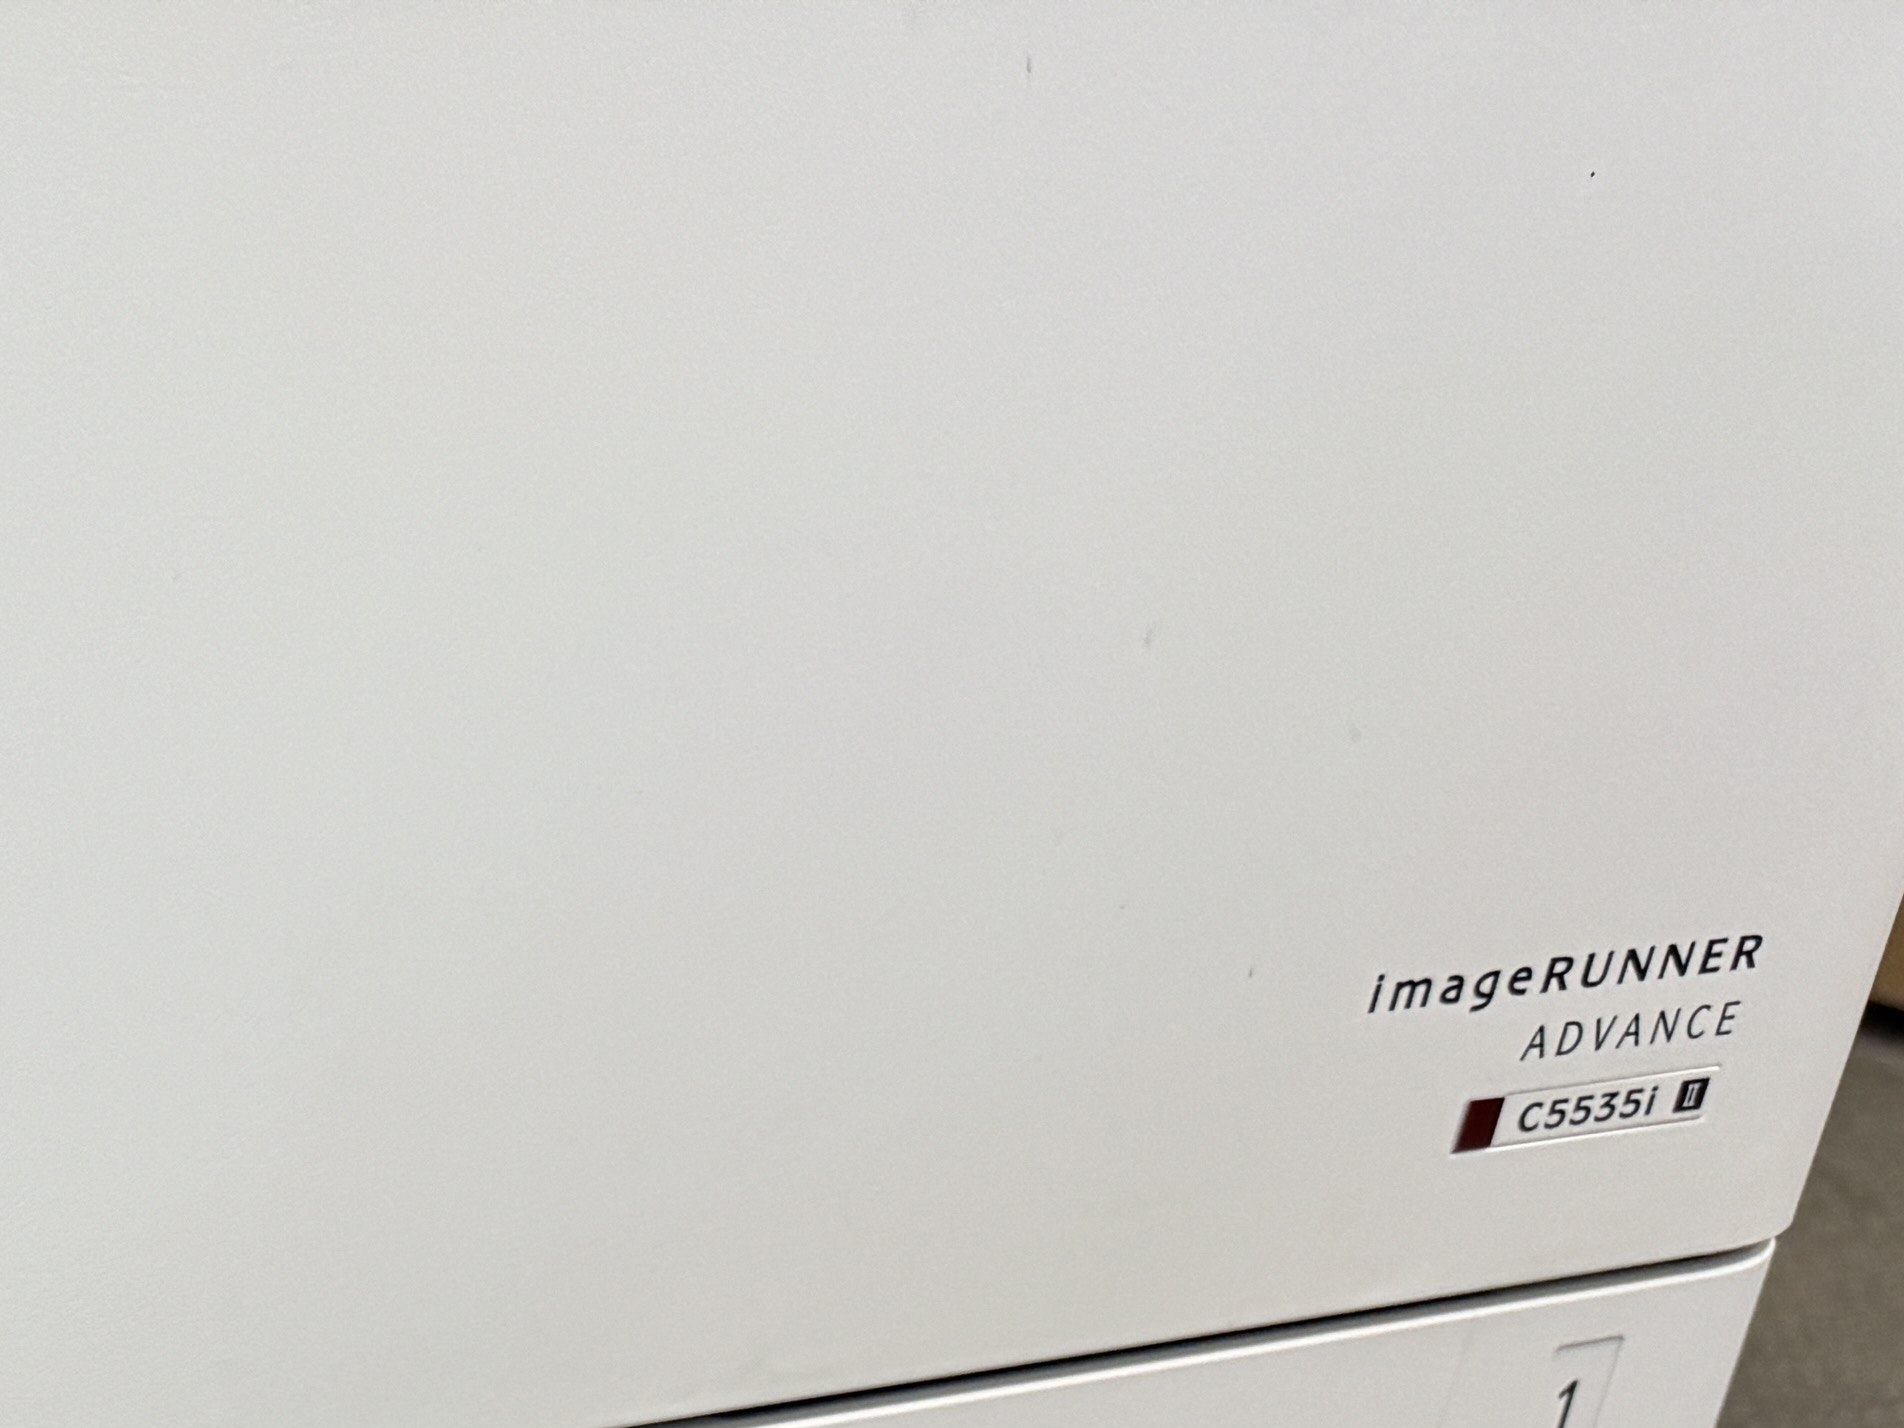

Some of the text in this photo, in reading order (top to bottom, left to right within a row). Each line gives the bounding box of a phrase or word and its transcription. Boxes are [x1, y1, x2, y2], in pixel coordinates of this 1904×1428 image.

[1368, 934, 1763, 1013] imageRUNNER
[1520, 1001, 1741, 1061] ADVANCE
[1518, 1086, 1658, 1132] C5535i
